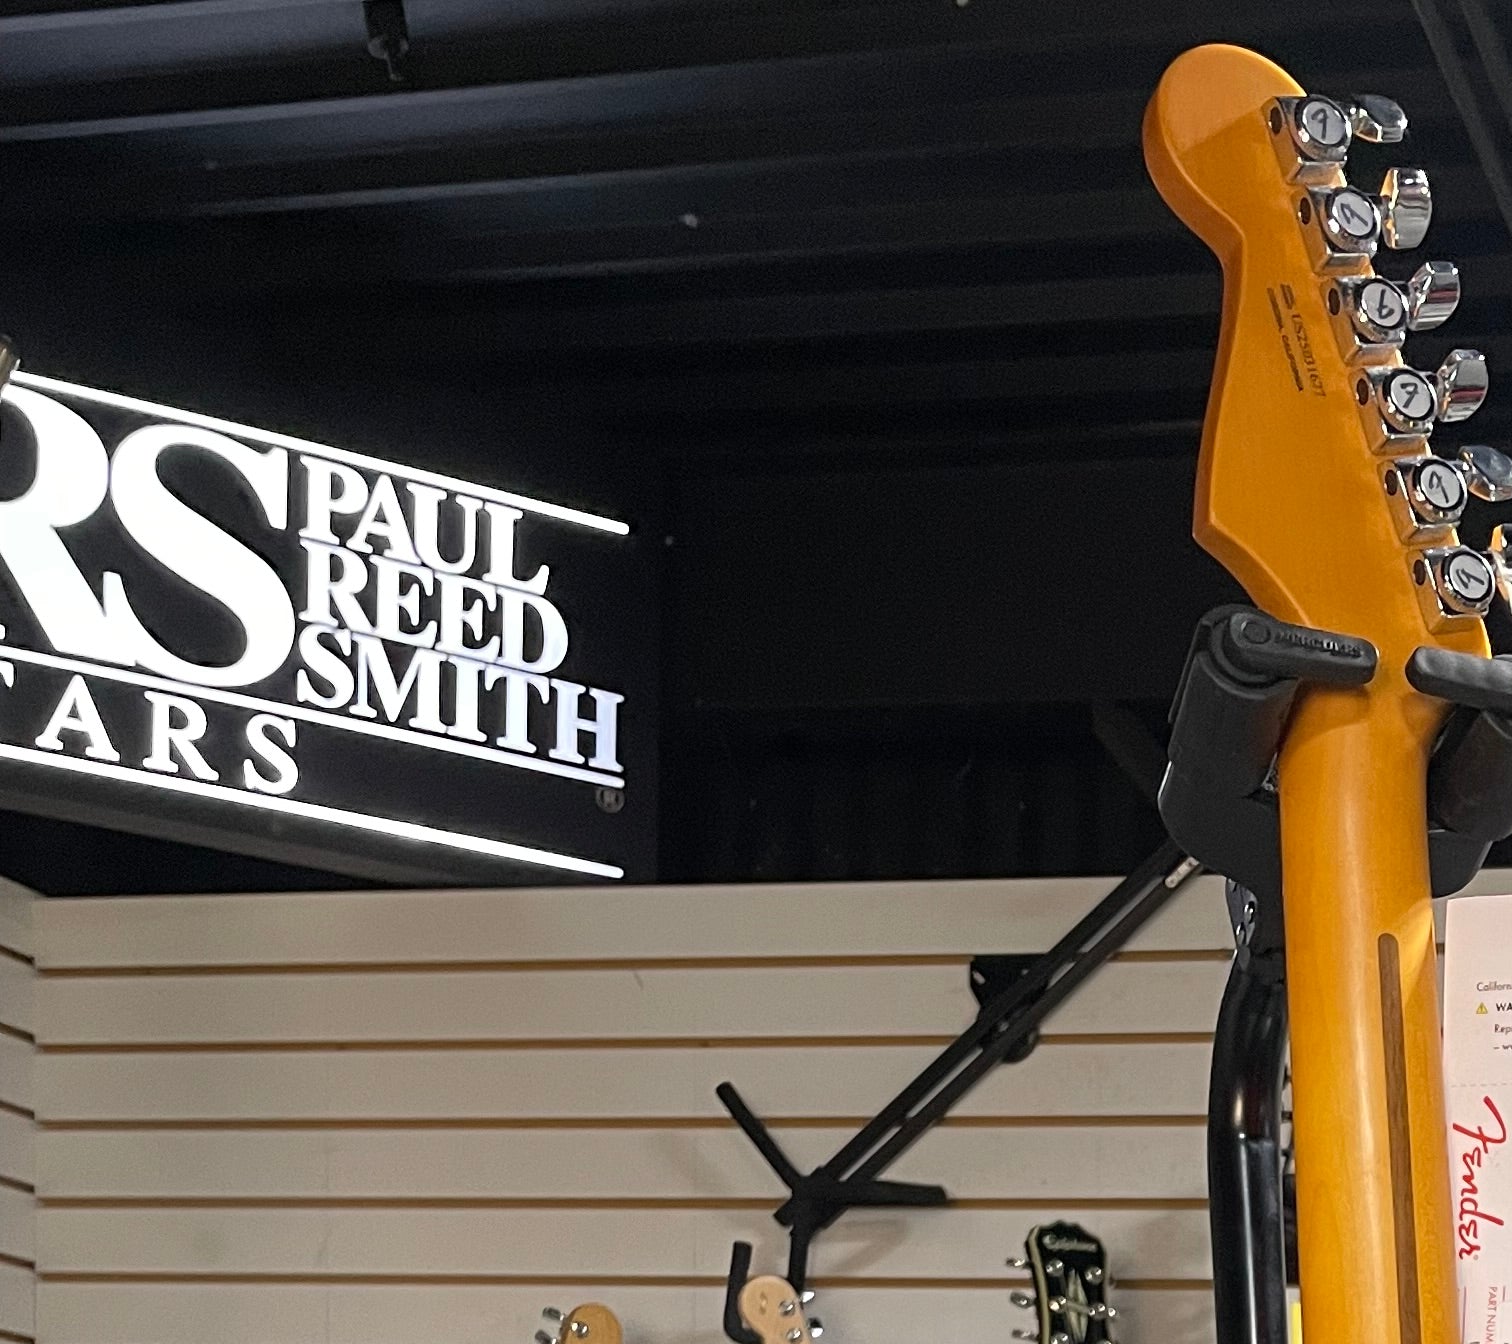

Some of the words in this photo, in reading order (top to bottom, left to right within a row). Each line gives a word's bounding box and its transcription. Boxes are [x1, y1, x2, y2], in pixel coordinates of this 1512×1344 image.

[0, 383, 296, 688] RS
[299, 453, 550, 596] PAUL
[299, 540, 569, 675] REED
[0, 662, 299, 796] ARS
[297, 624, 625, 773] SMITH
[1452, 1095, 1507, 1260] Fender
[1486, 1286, 1498, 1310] PART
